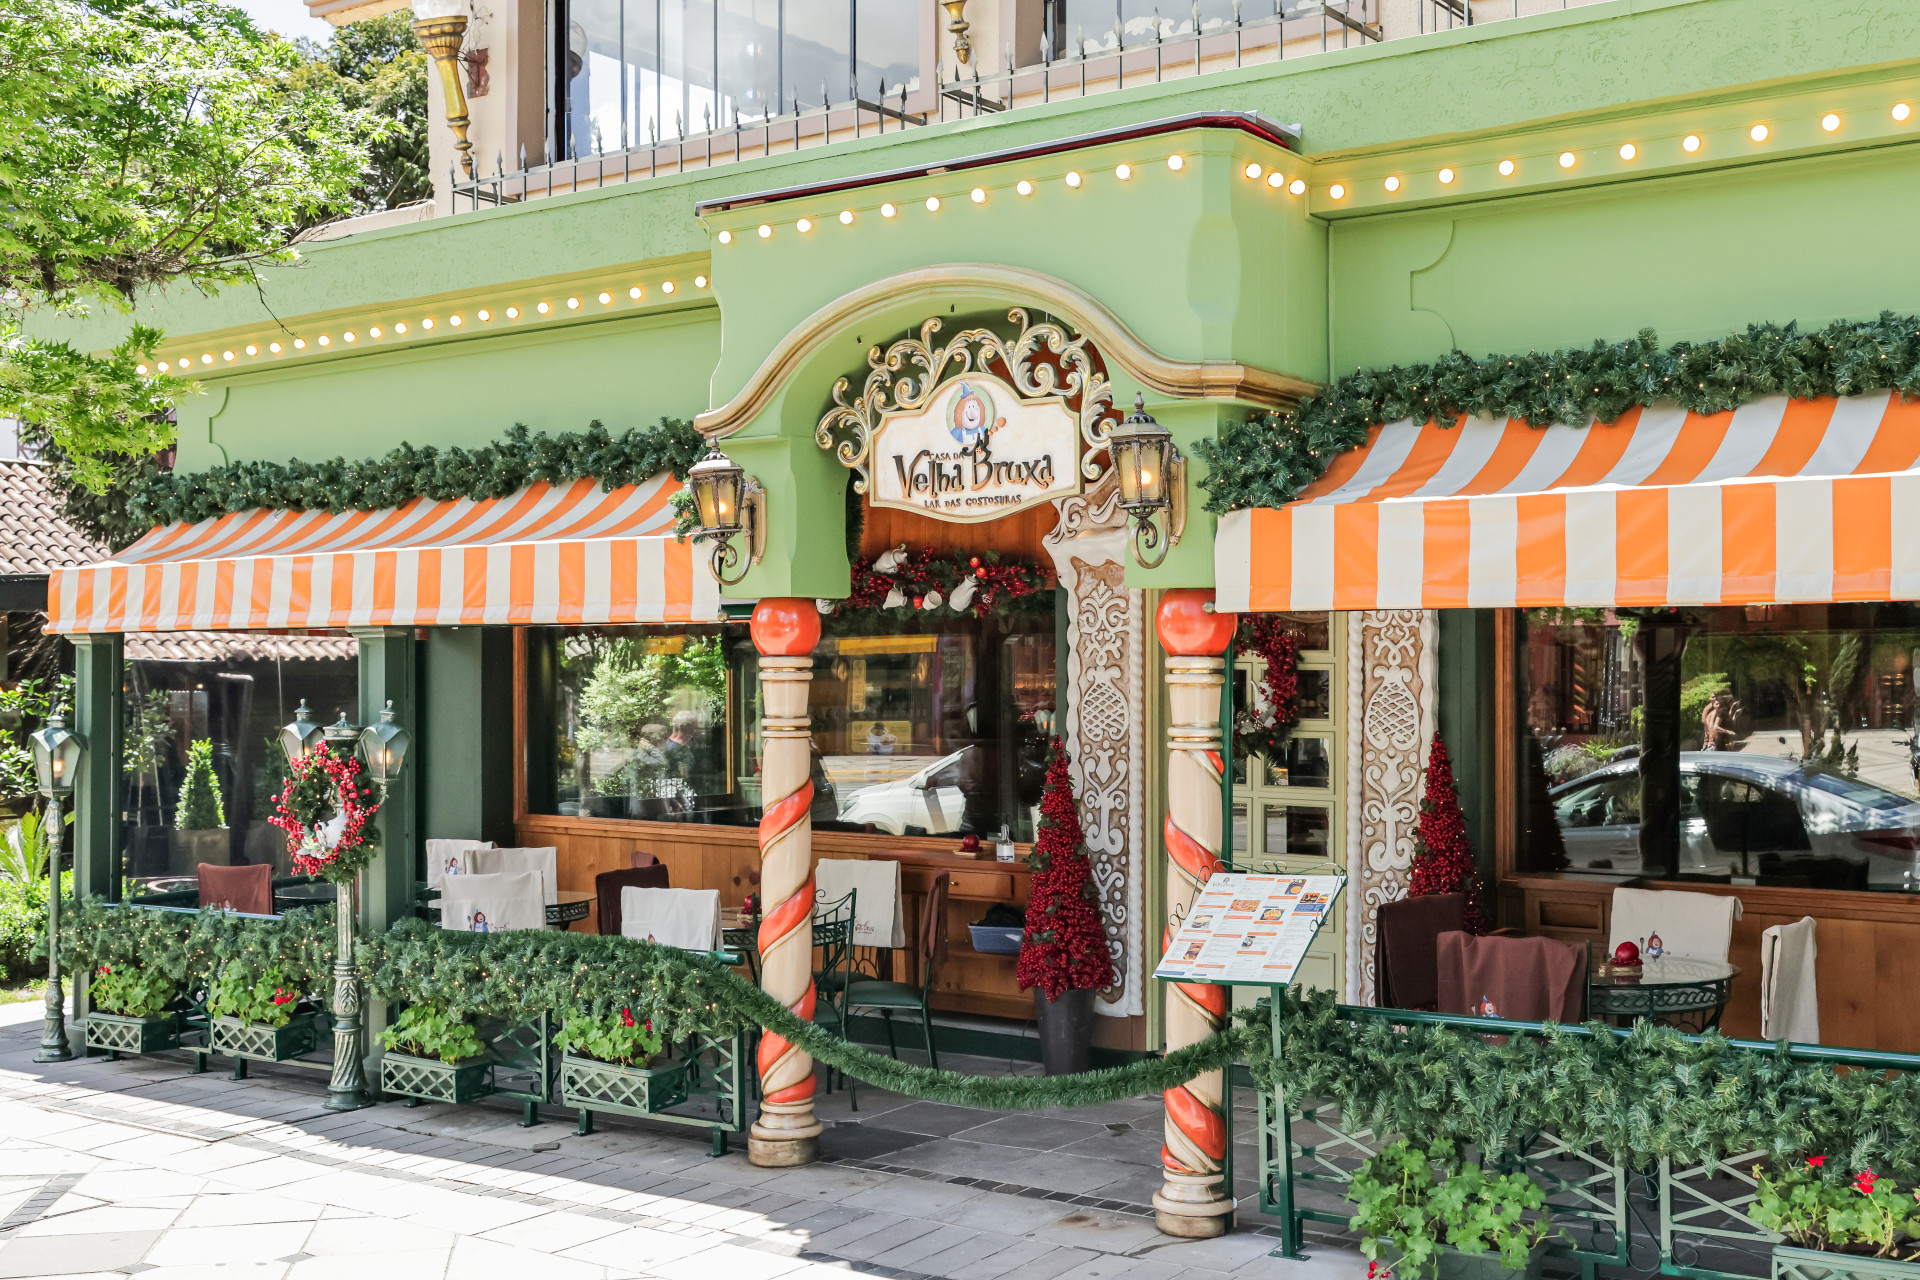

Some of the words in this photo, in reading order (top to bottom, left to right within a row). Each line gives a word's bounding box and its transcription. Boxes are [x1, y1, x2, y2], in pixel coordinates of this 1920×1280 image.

[892, 449, 965, 500] Velha
[960, 428, 1055, 492] Bruxa
[928, 452, 951, 461] CASA
[953, 452, 965, 460] DA
[924, 499, 942, 510] LAR
[944, 497, 962, 508] DAS
[965, 494, 1022, 507] GOSTOSURAS
